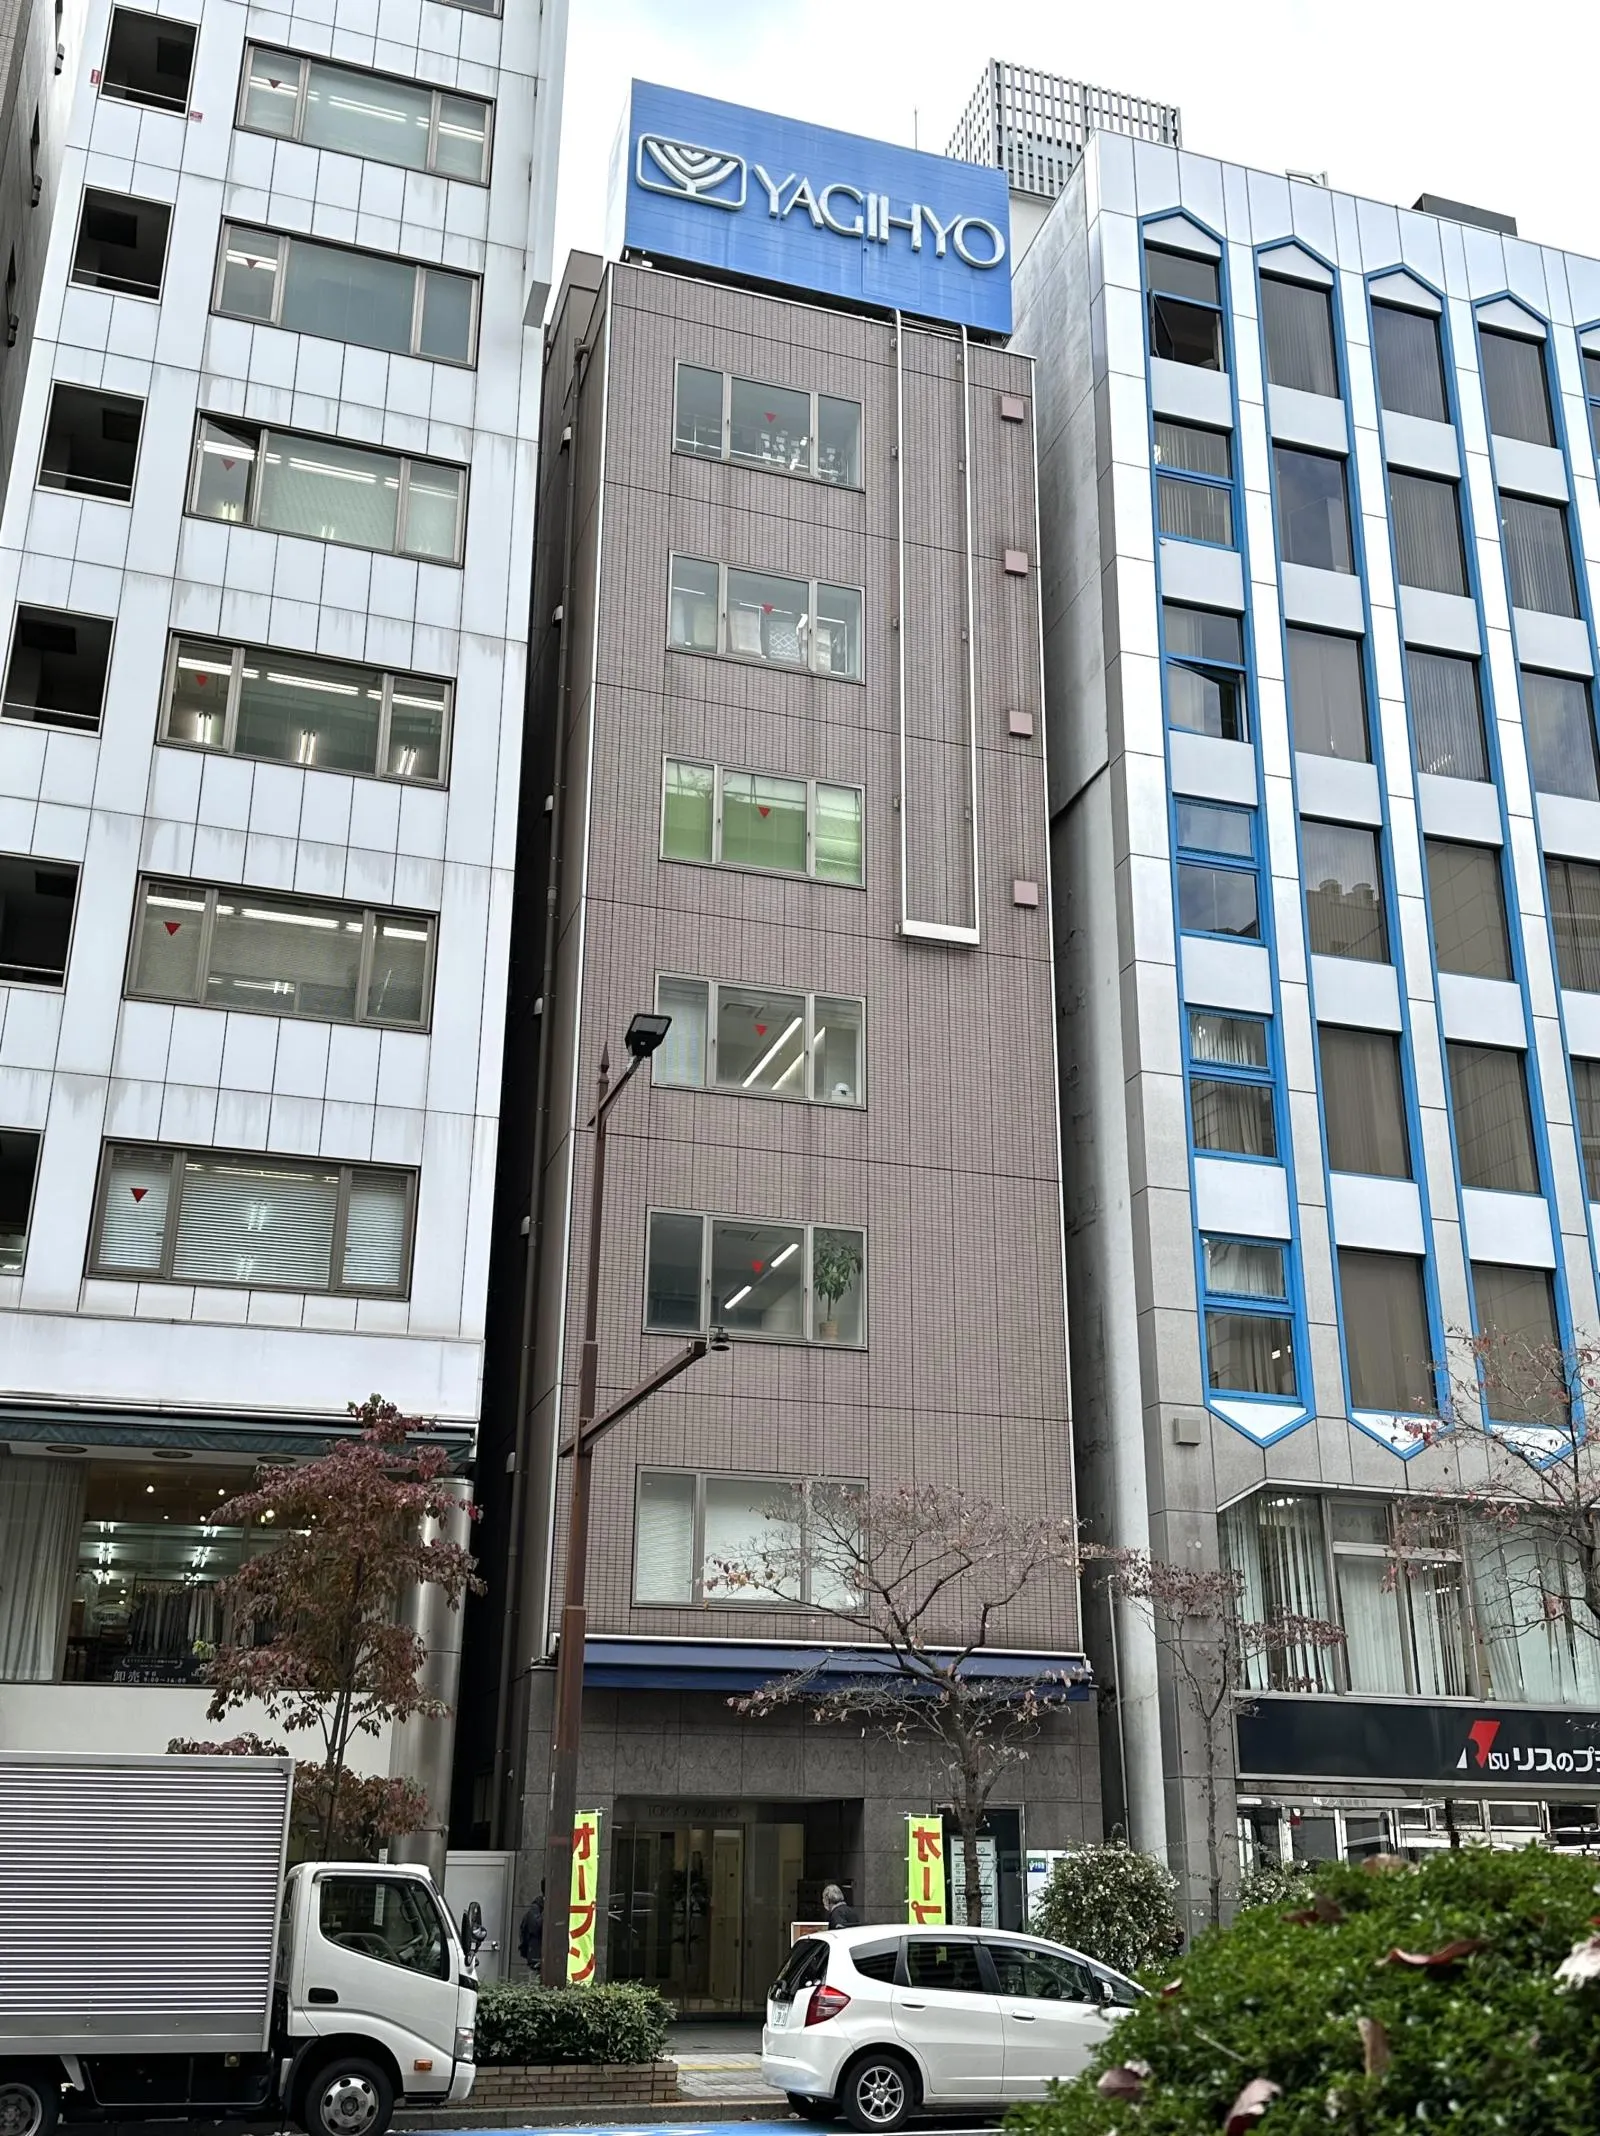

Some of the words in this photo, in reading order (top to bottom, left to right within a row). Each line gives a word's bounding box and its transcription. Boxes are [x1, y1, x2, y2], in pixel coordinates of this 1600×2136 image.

[752, 163, 1006, 269] YAGIHYO
[1512, 1745, 1600, 1773] リスのプ
[568, 1822, 597, 1982] オープン
